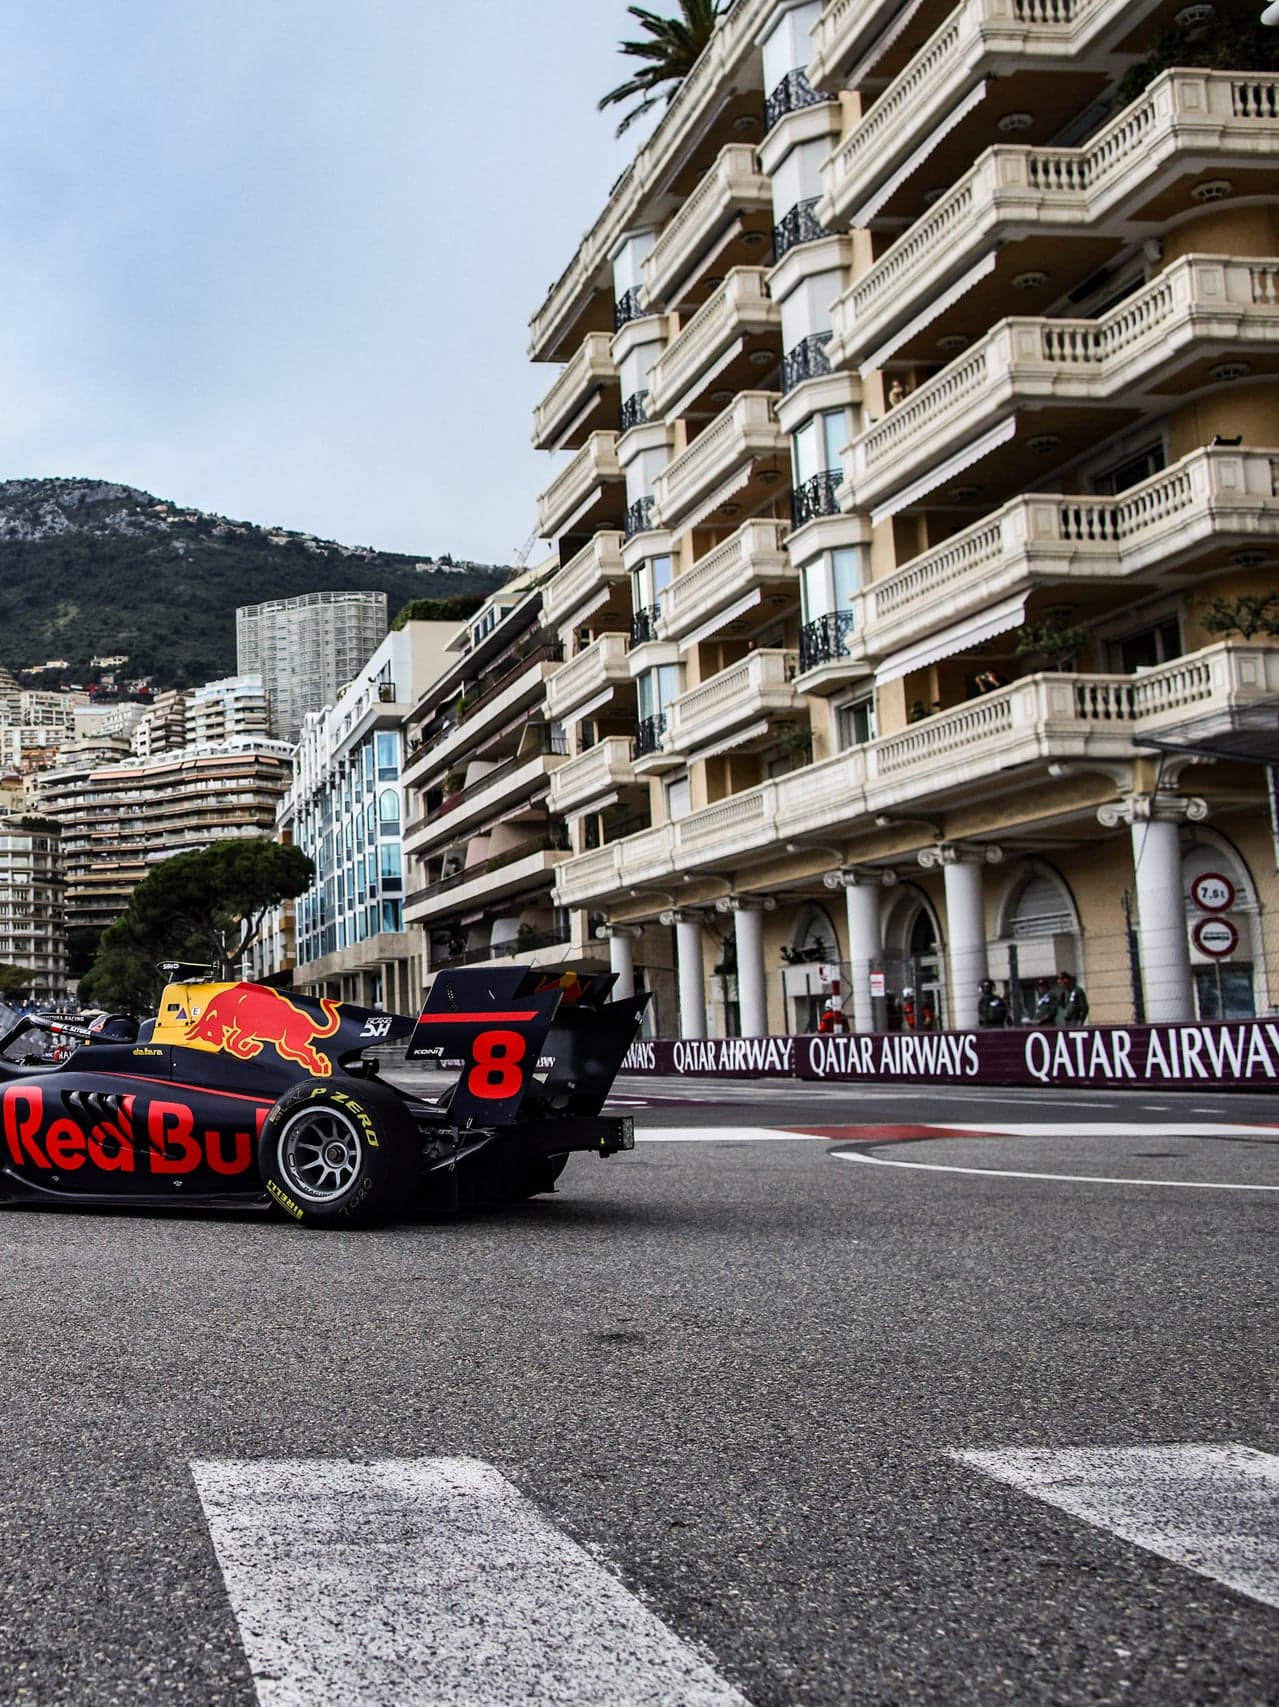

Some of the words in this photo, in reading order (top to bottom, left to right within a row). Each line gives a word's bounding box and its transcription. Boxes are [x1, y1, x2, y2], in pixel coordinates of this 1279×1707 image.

[467, 1030, 526, 1099] 8
[673, 1041, 717, 1073] QATAR
[809, 1037, 876, 1076] QATAR
[880, 1034, 979, 1076] AIRWAYS
[1025, 1030, 1137, 1082] QATAR
[2, 1085, 137, 1173] Red
[310, 1087, 328, 1099] P
[330, 1091, 380, 1148] ZERO
[265, 1179, 305, 1220] PIRELLI
